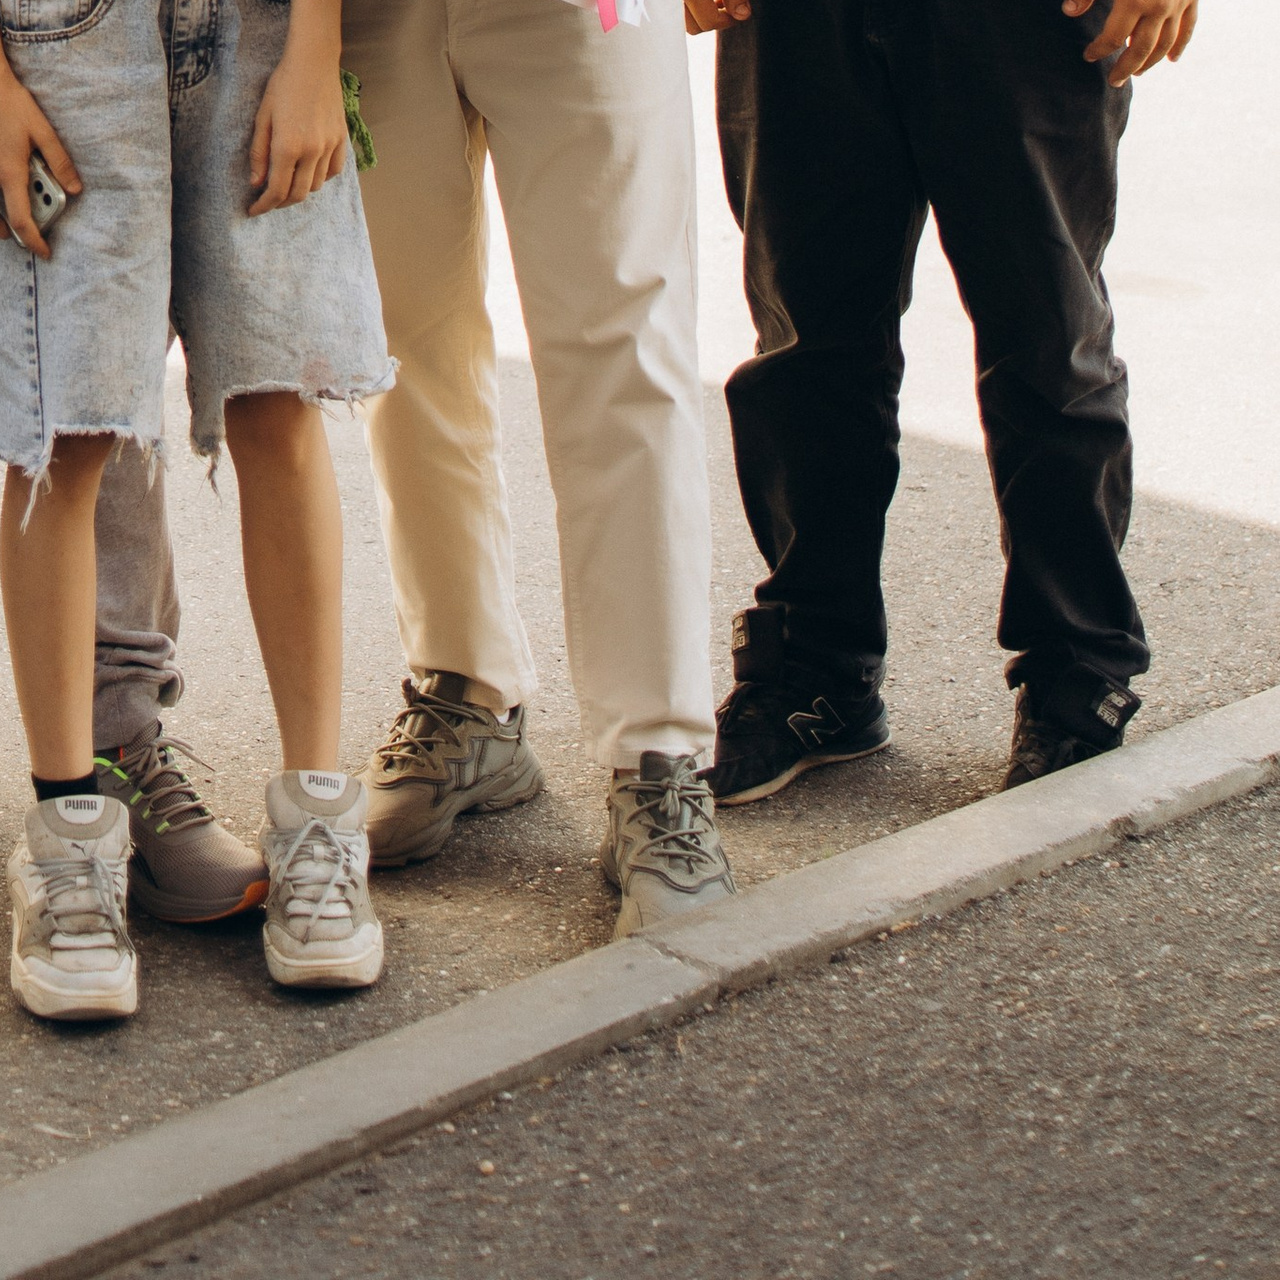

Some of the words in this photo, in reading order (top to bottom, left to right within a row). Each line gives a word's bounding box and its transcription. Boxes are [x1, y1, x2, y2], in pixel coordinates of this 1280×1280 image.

[1099, 709, 1116, 725] 574
[308, 774, 340, 790] PUMA
[65, 799, 98, 811] PUMA
